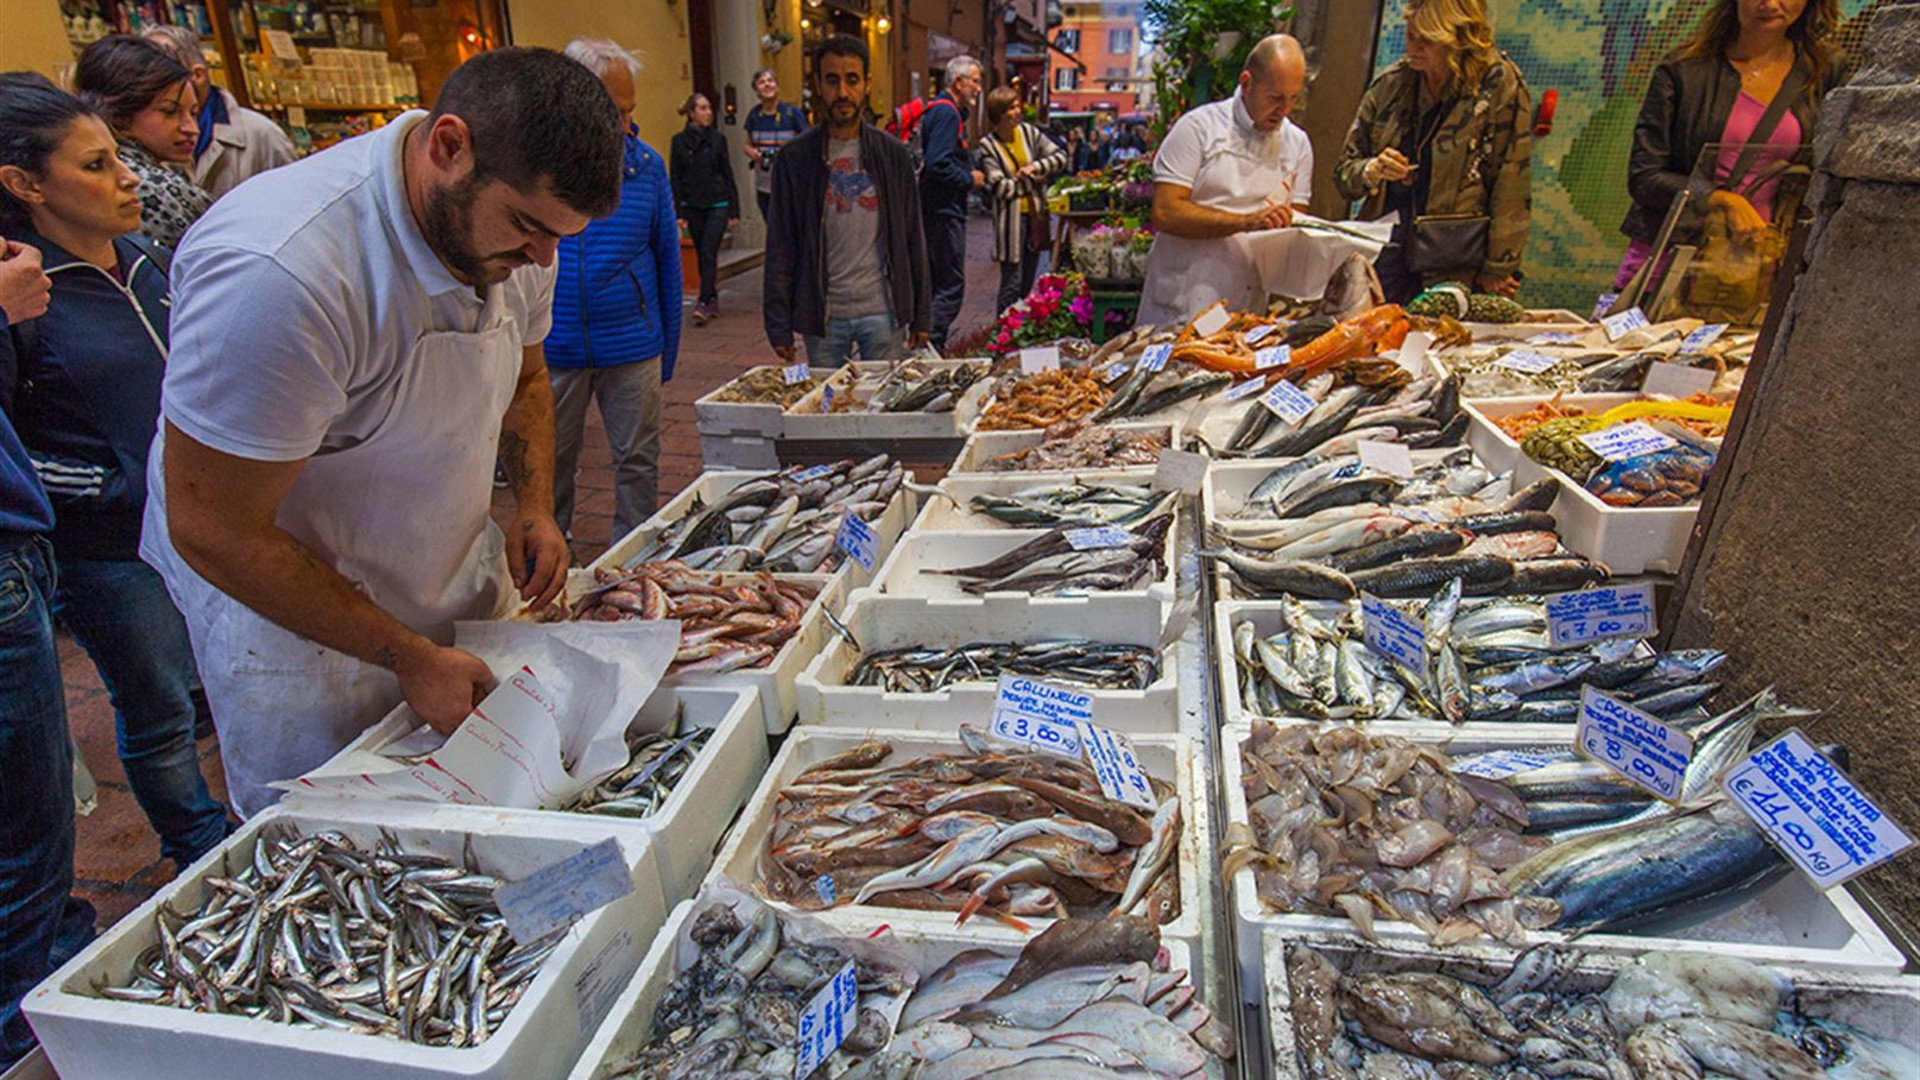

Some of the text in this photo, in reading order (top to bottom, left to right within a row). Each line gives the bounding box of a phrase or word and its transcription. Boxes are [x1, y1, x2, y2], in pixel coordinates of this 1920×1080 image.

[1014, 718, 1061, 743] 3,00
[1603, 735, 1656, 778] 8,00
[1735, 779, 1831, 871] € 11,00 Kg
